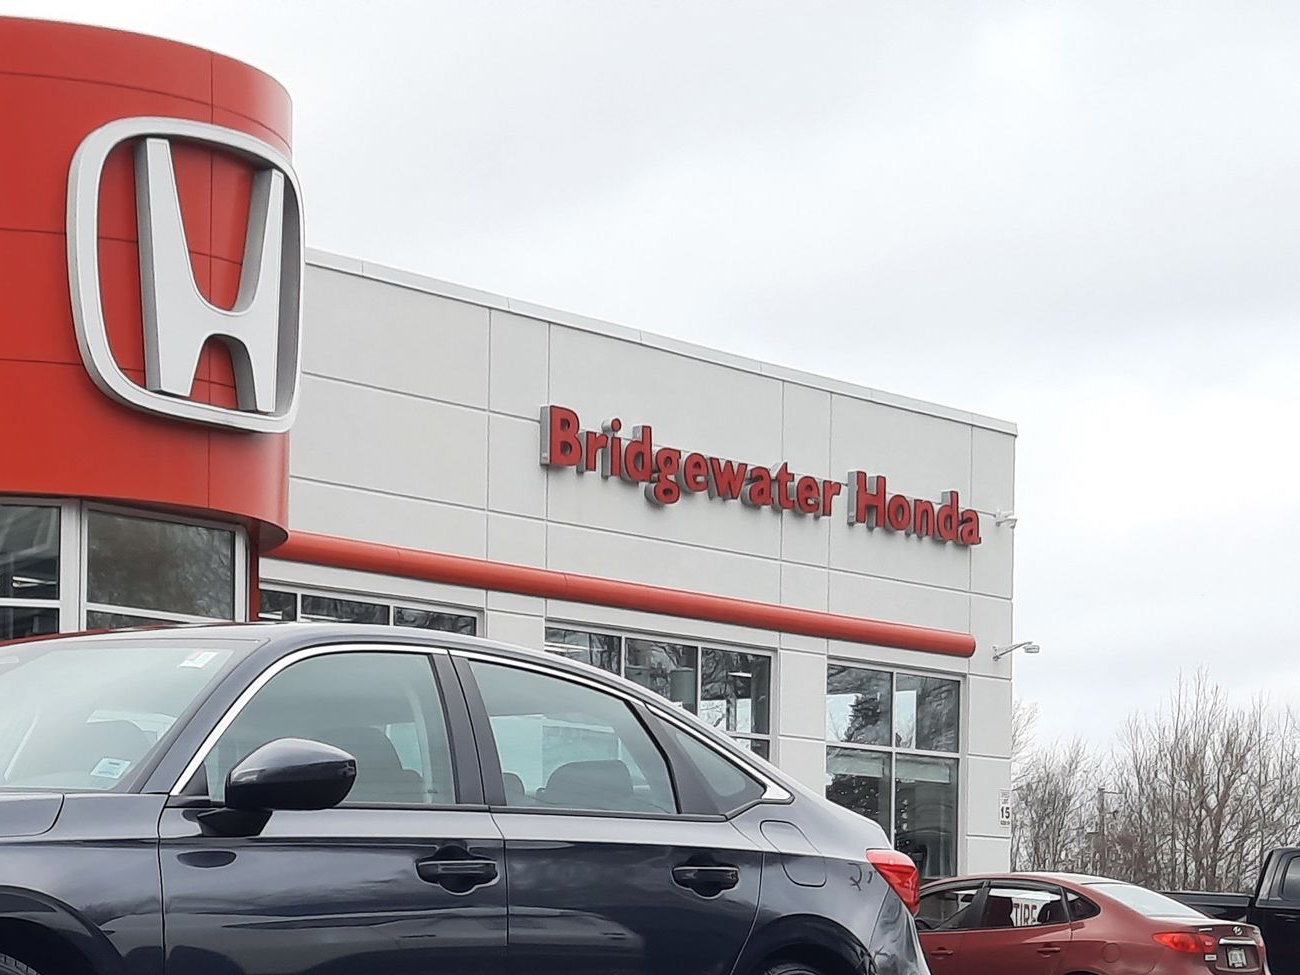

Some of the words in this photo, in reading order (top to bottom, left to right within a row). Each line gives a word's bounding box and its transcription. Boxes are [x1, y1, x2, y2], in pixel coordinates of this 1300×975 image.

[546, 405, 841, 516] Bridgewater
[852, 471, 981, 545] Honda
[1001, 806, 1010, 819] 15
